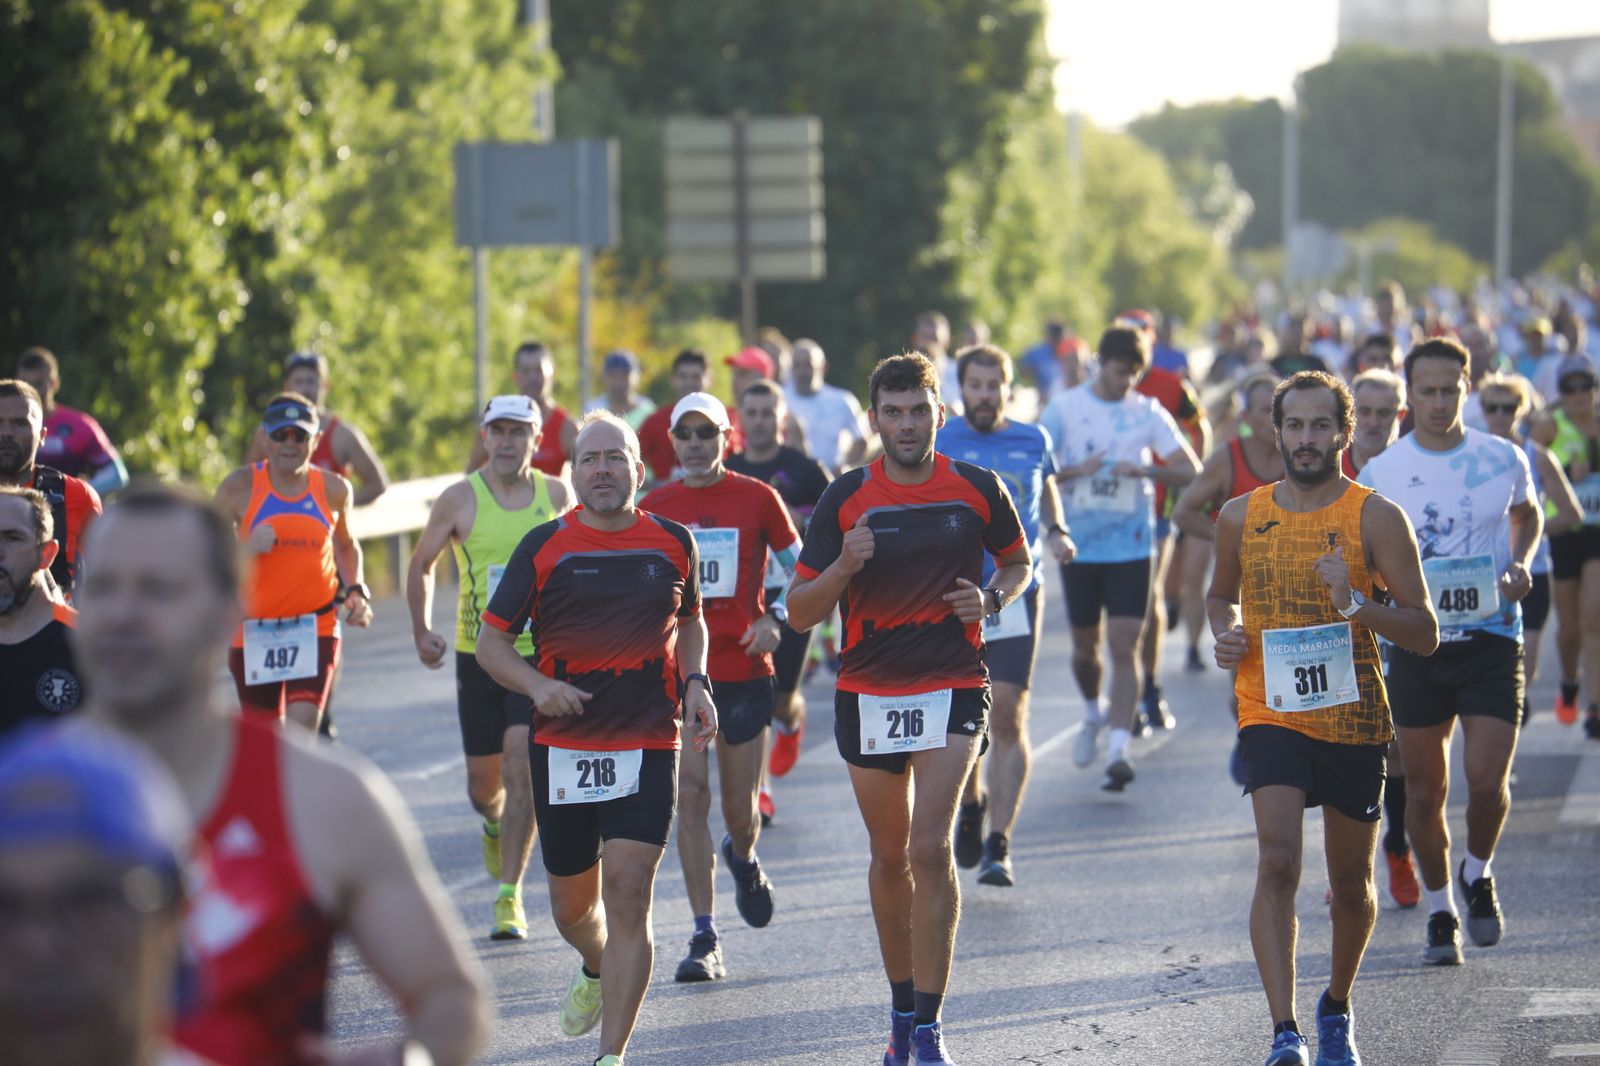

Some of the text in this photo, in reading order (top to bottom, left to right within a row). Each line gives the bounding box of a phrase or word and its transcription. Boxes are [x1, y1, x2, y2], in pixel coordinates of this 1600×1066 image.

[1268, 635, 1349, 655] MEDIA MARATÓN
[1294, 663, 1328, 696] 311
[886, 708, 924, 739] 216
[576, 757, 617, 788] 218
